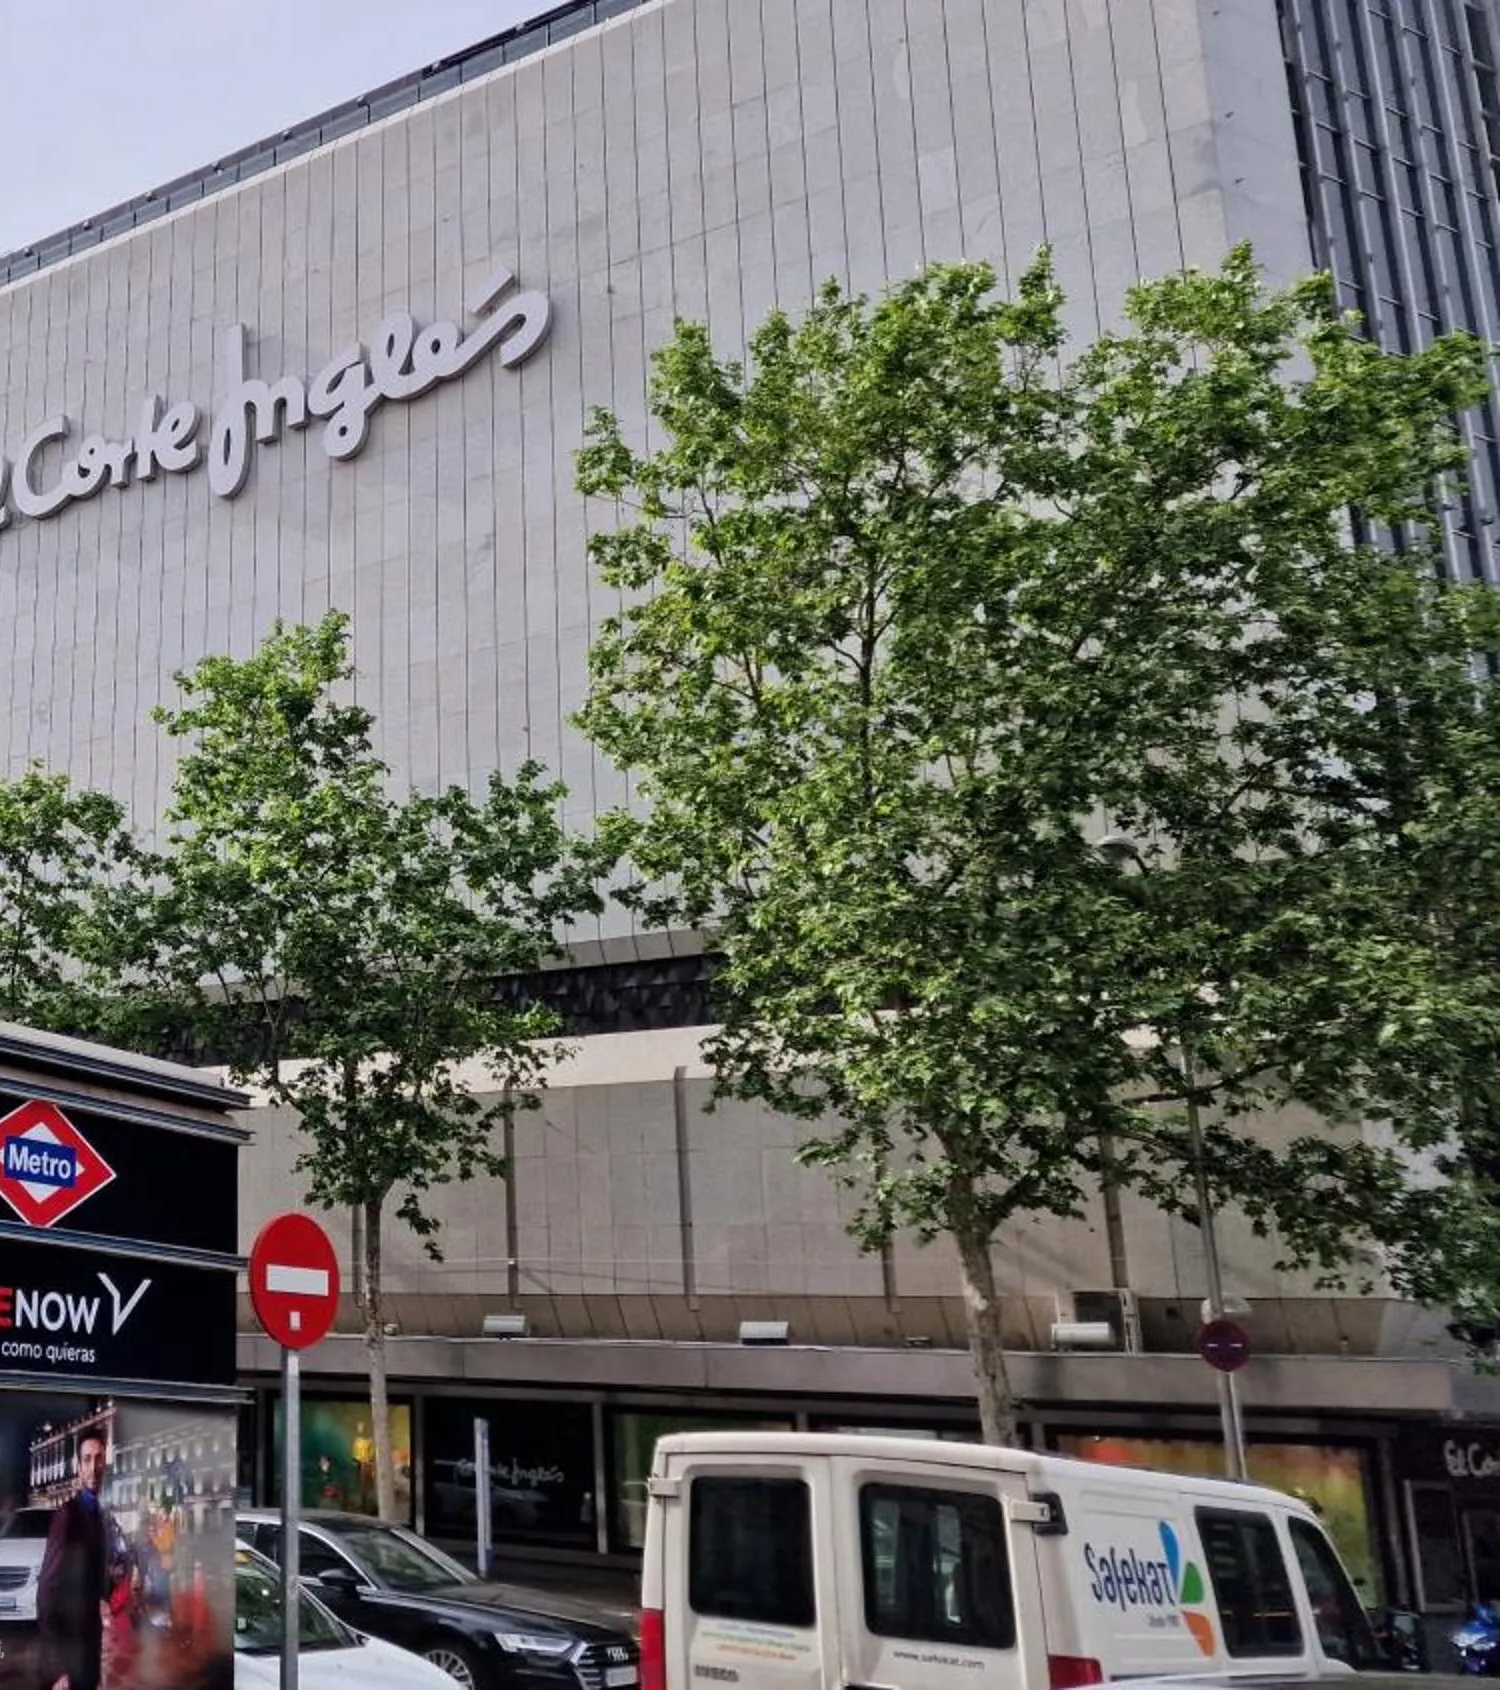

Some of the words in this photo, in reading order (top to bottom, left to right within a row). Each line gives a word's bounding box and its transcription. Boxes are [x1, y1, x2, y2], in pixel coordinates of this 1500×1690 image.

[12, 394, 202, 519] Corte
[206, 266, 552, 498] Inglés
[8, 1143, 72, 1180] Metro
[1, 1341, 42, 1359] como
[45, 1342, 96, 1364] quieras
